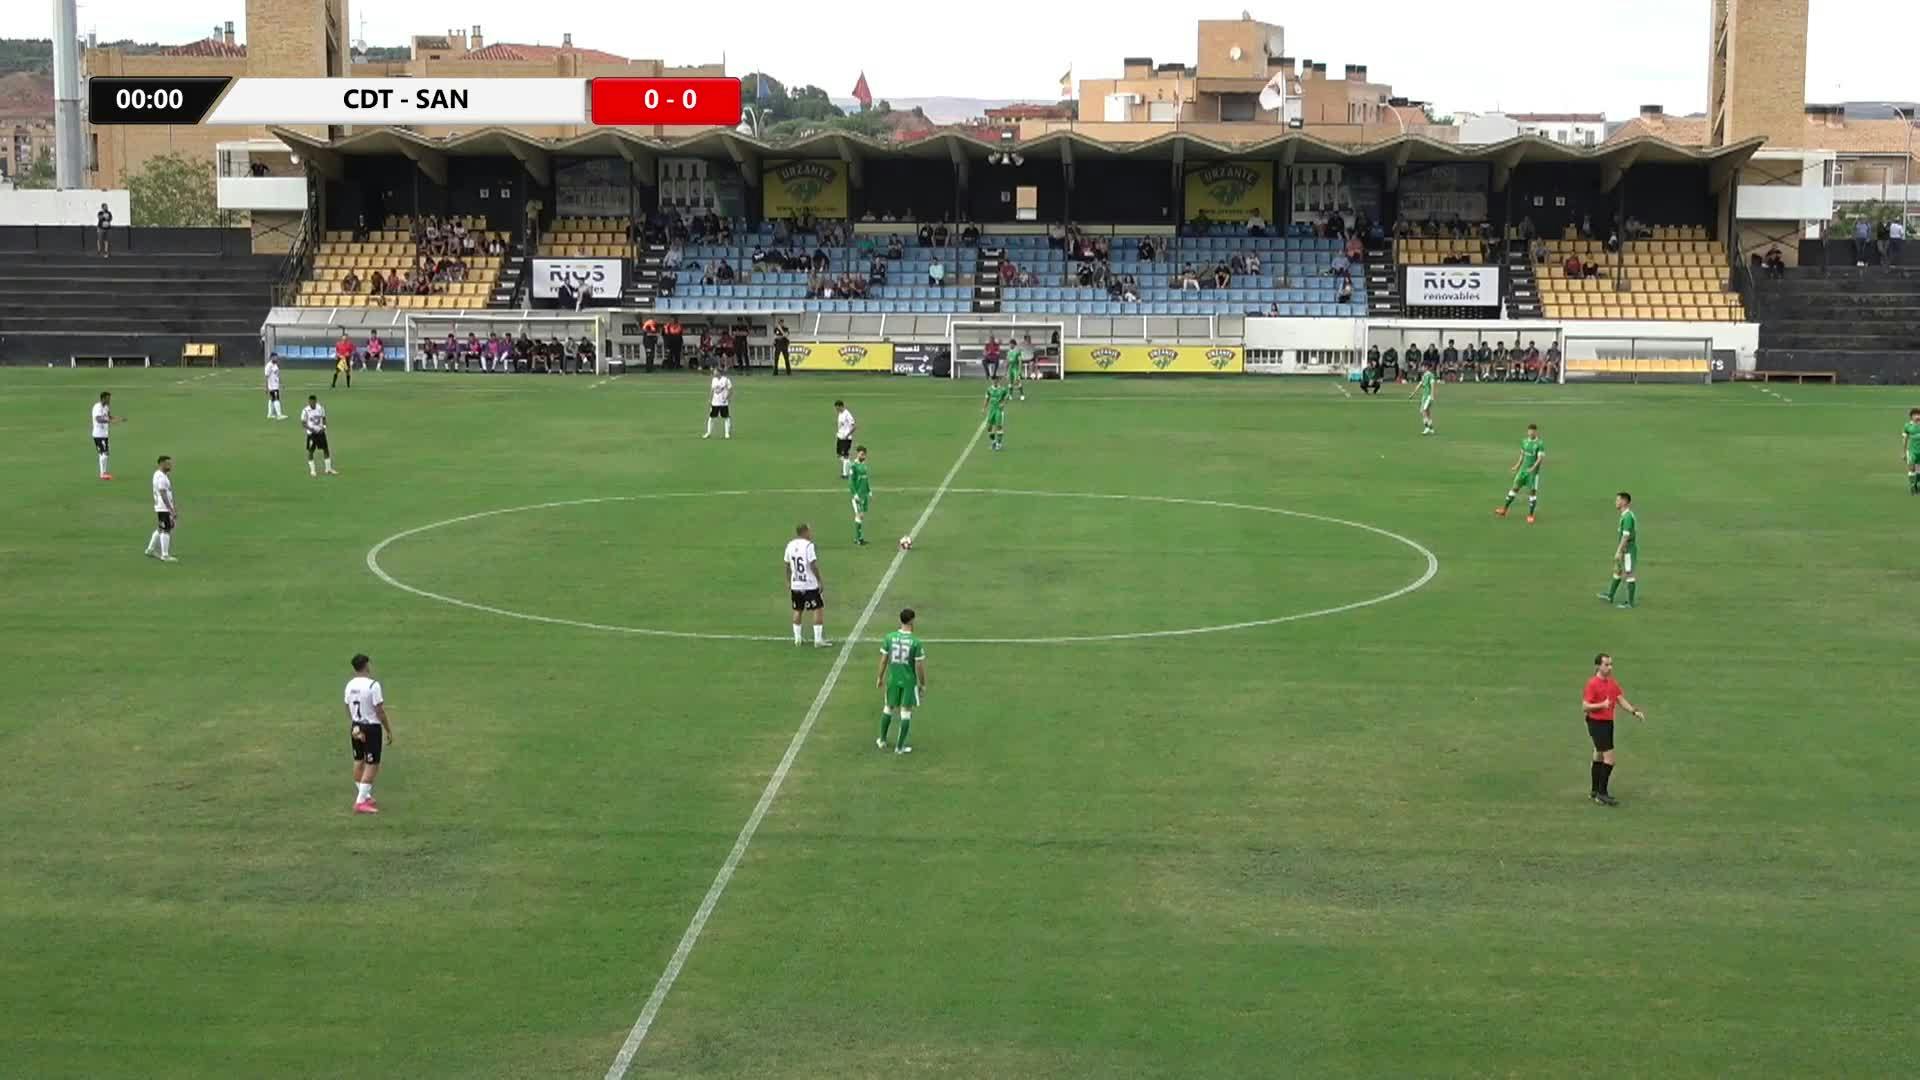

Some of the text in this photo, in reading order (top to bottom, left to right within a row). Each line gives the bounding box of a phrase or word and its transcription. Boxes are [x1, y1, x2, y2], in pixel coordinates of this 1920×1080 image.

[1423, 292, 1481, 301] renovables
[791, 556, 805, 573] 16
[352, 701, 362, 719] 7
